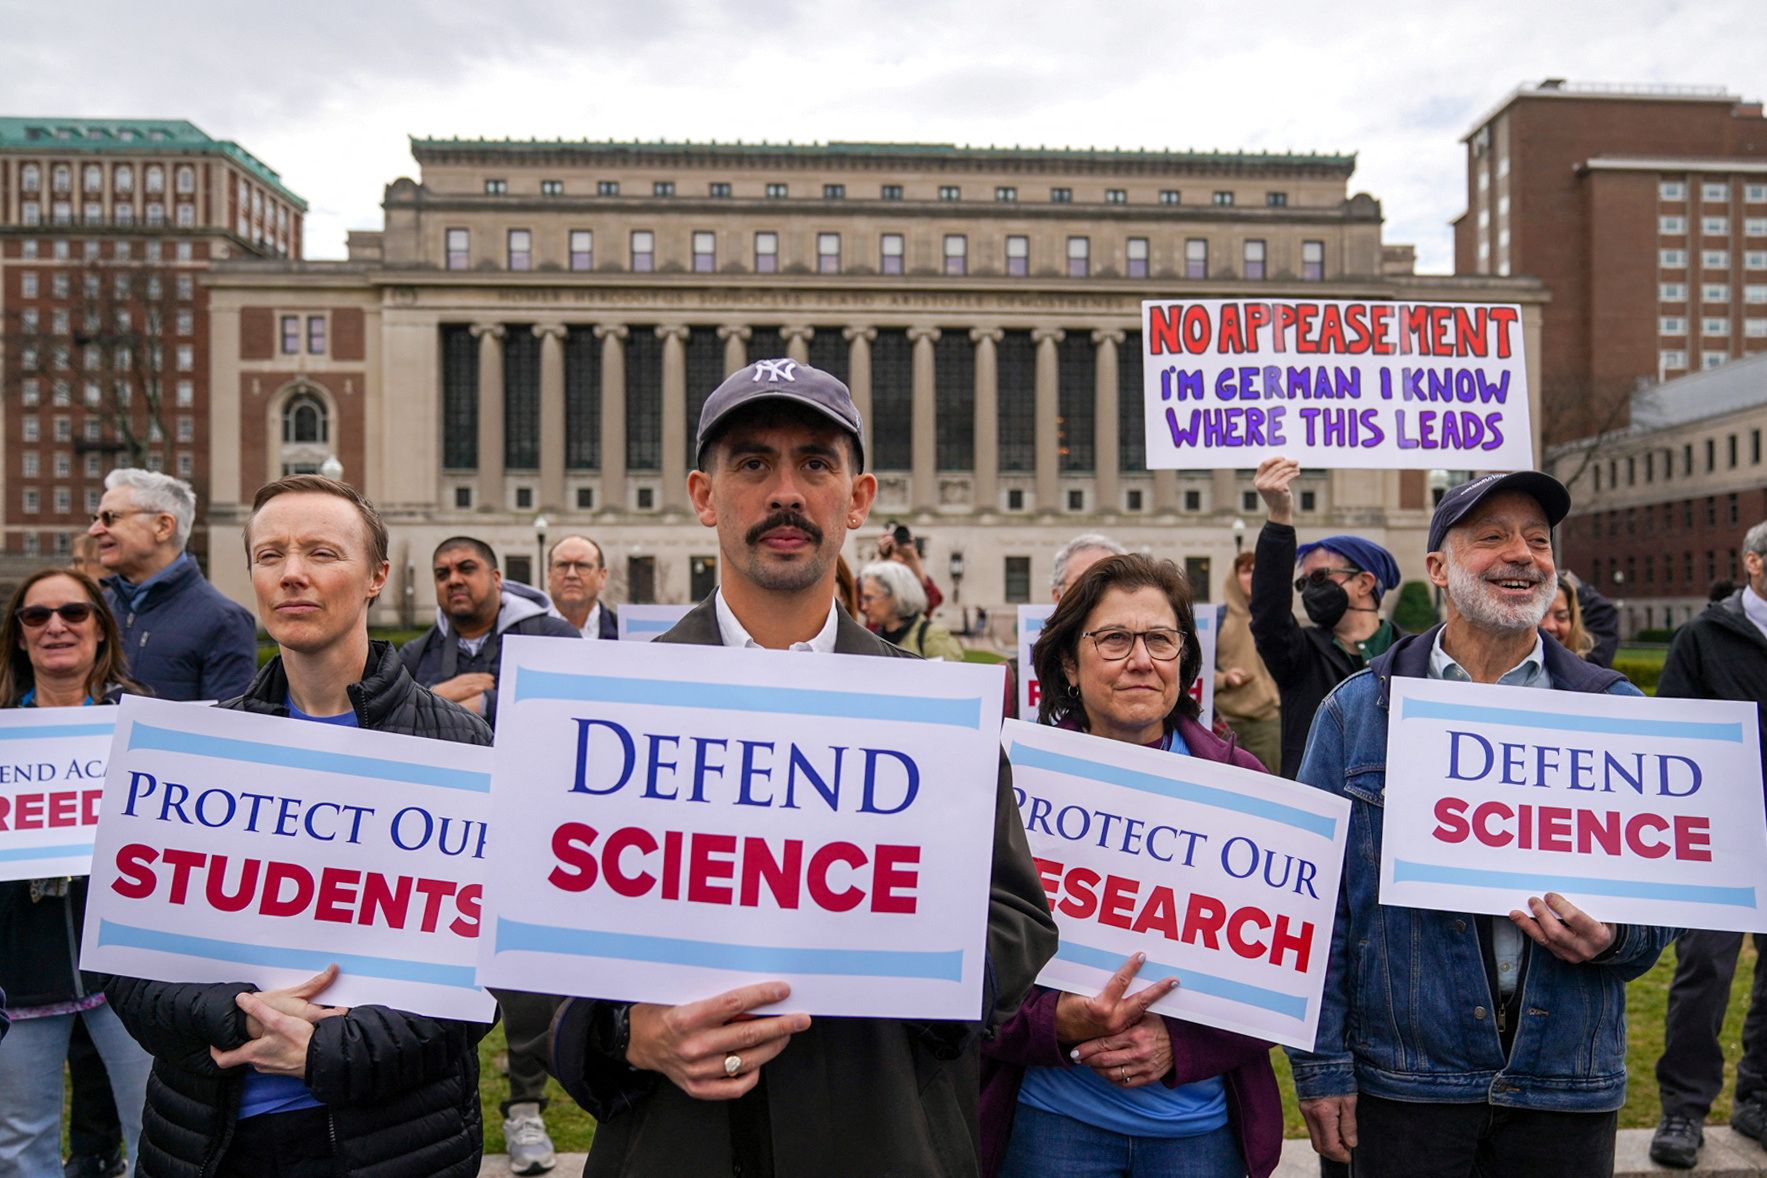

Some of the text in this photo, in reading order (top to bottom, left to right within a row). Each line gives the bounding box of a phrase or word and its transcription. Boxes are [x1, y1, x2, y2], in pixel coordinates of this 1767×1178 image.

[1149, 303, 1518, 359] NO APPEASEMENT
[752, 358, 796, 383] NY
[1161, 365, 1511, 404] I'M GERMAN I KNOW
[1165, 406, 1504, 451] WHERE THIS LEADS
[0, 759, 109, 784] END AC
[568, 717, 920, 815] DEFEND
[1446, 730, 1703, 797] DEFEND
[121, 770, 376, 844] PROTECT
[1432, 797, 1712, 862] SCIENCE
[111, 843, 483, 938] STUDENTS
[547, 822, 921, 915] SCIENCE
[1220, 836, 1320, 900] OUR
[1033, 856, 1316, 974] ESEARCH
